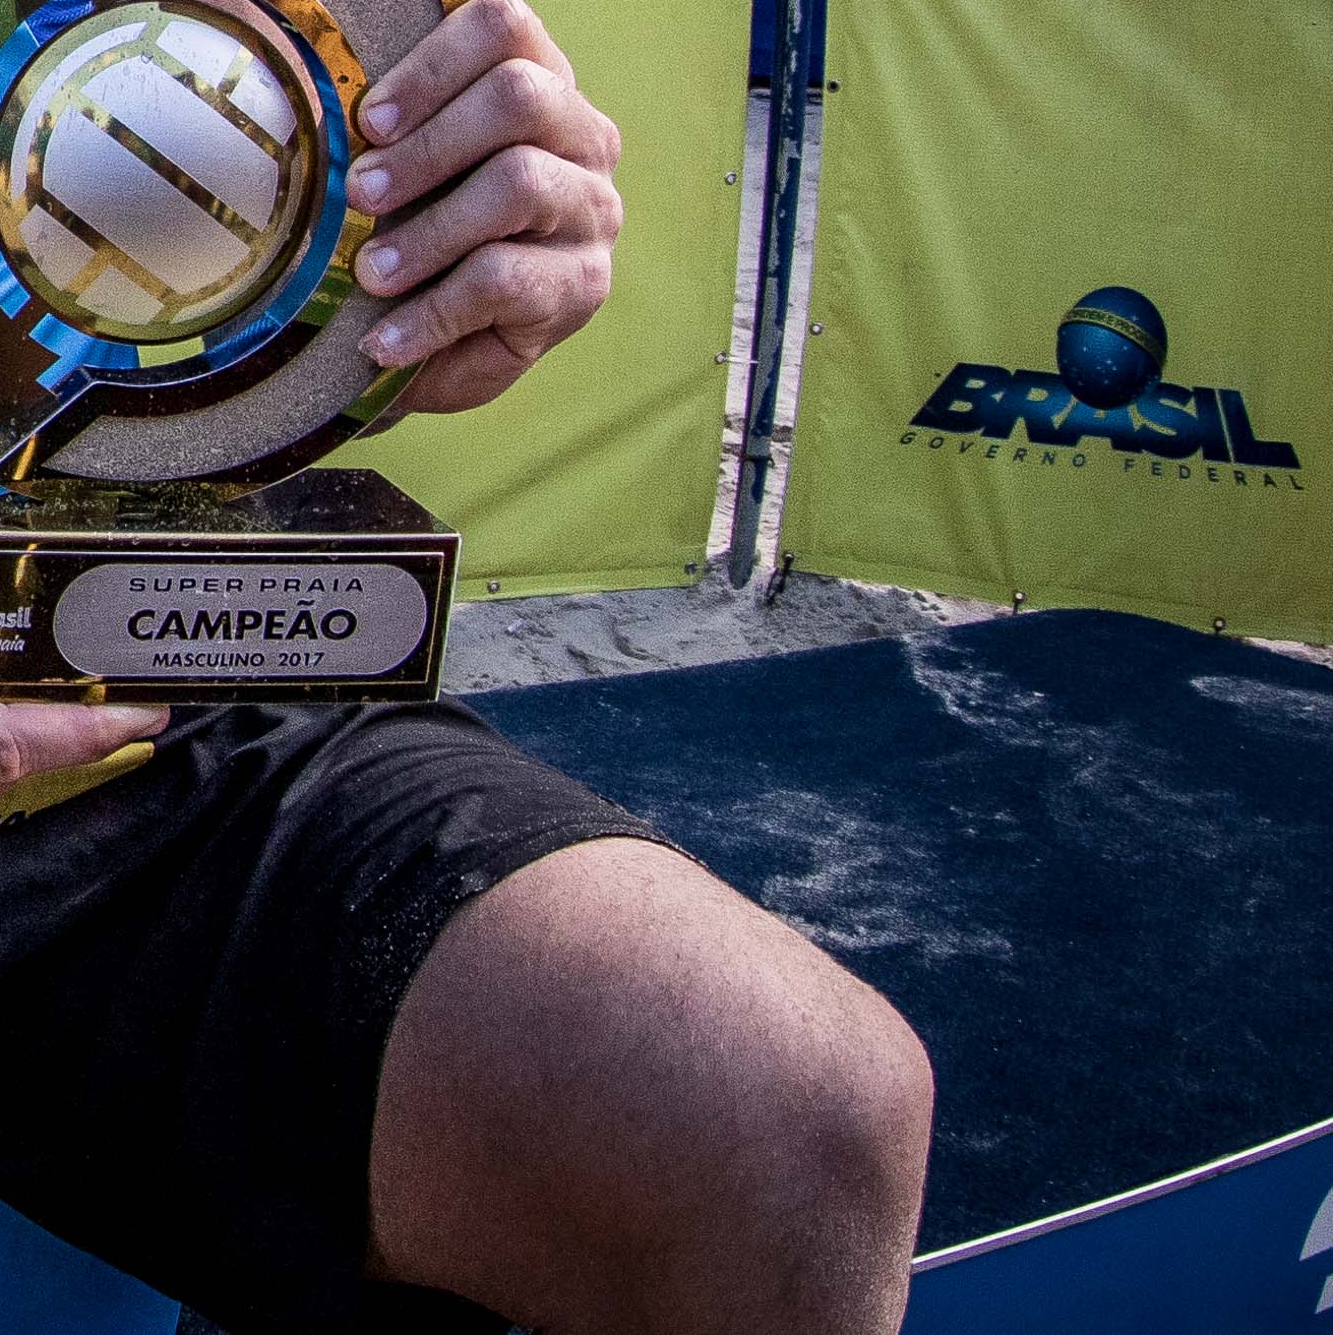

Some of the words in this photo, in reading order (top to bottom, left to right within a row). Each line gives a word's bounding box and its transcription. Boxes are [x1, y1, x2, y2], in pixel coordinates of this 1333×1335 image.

[909, 362, 1301, 469] BRASIL
[899, 431, 1087, 470] GOVERNO
[1124, 458, 1305, 492] FEDERAL
[129, 577, 244, 592] SUPER
[260, 577, 365, 593] PRAIA
[127, 601, 358, 641] CAMPEÃO
[152, 652, 265, 668] MASCULINO
[278, 651, 324, 667] 2017
